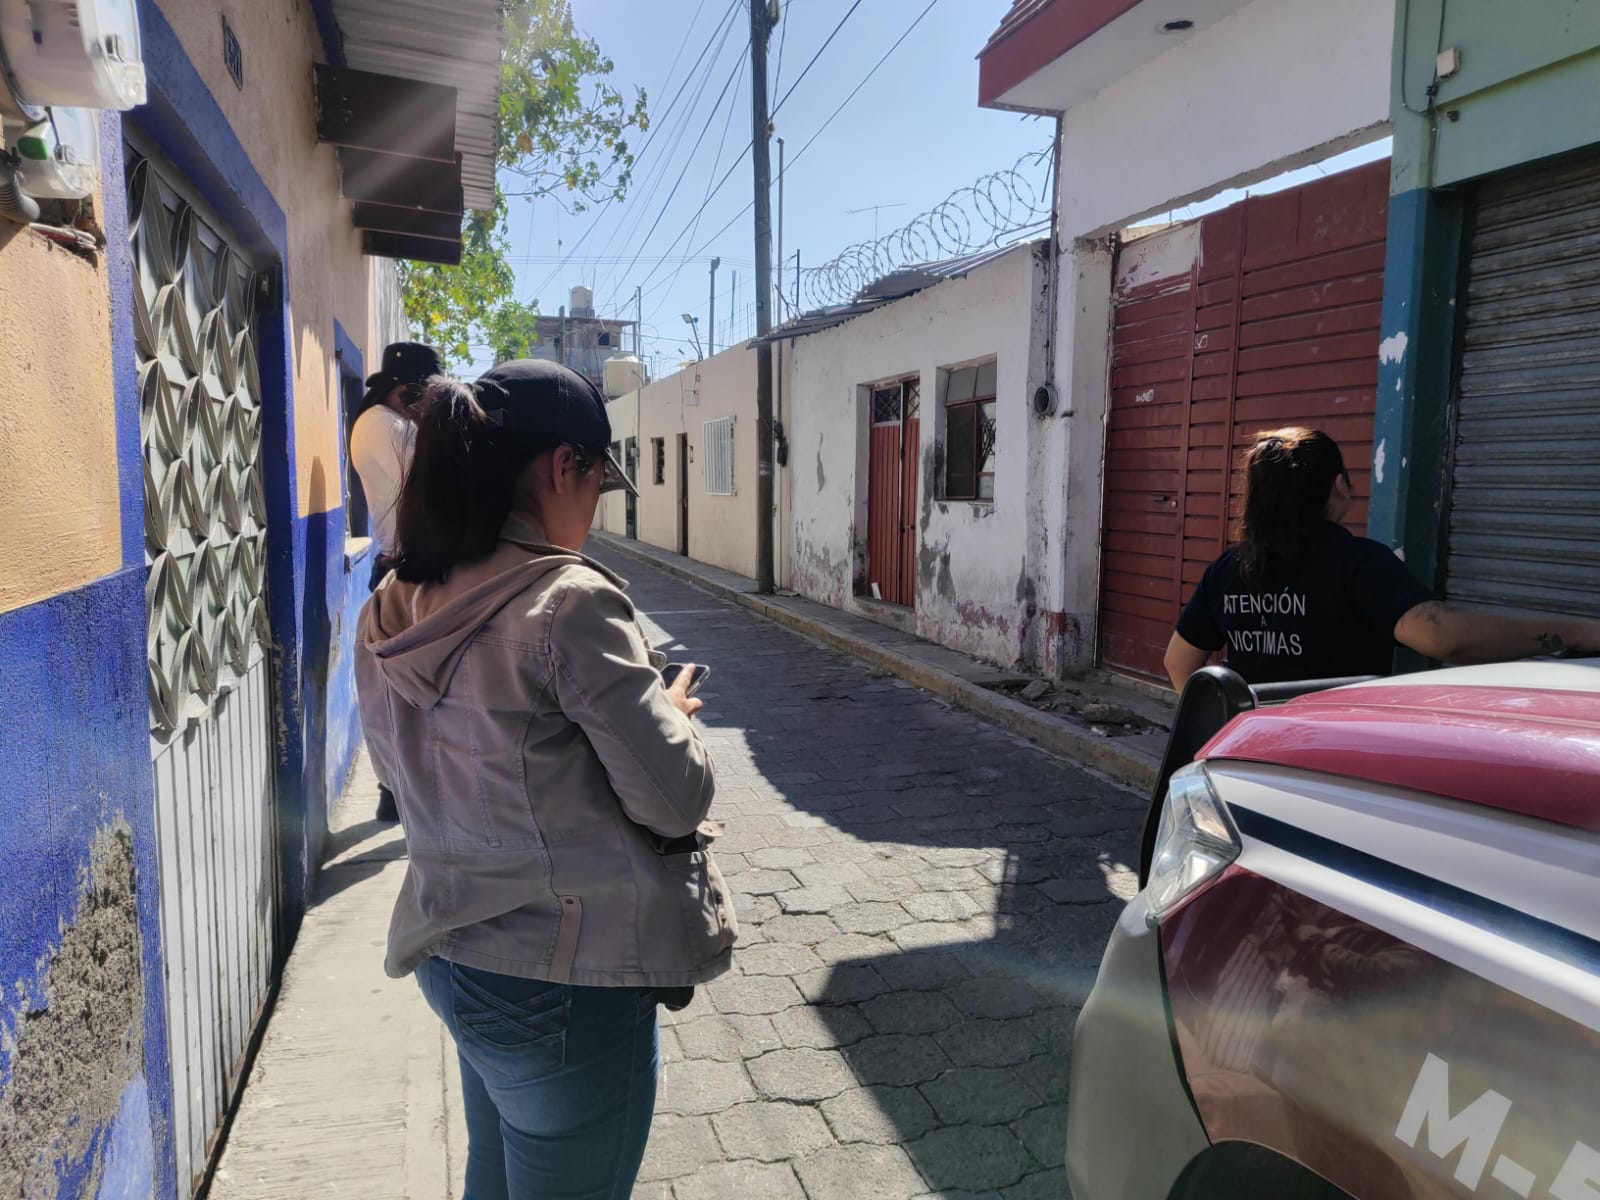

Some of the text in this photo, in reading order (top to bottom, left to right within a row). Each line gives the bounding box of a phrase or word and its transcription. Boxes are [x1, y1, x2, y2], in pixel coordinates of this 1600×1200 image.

[1223, 586, 1306, 616] ATENCIÓN
[1261, 615, 1267, 627] A
[1227, 630, 1303, 656] VICTIMAS
